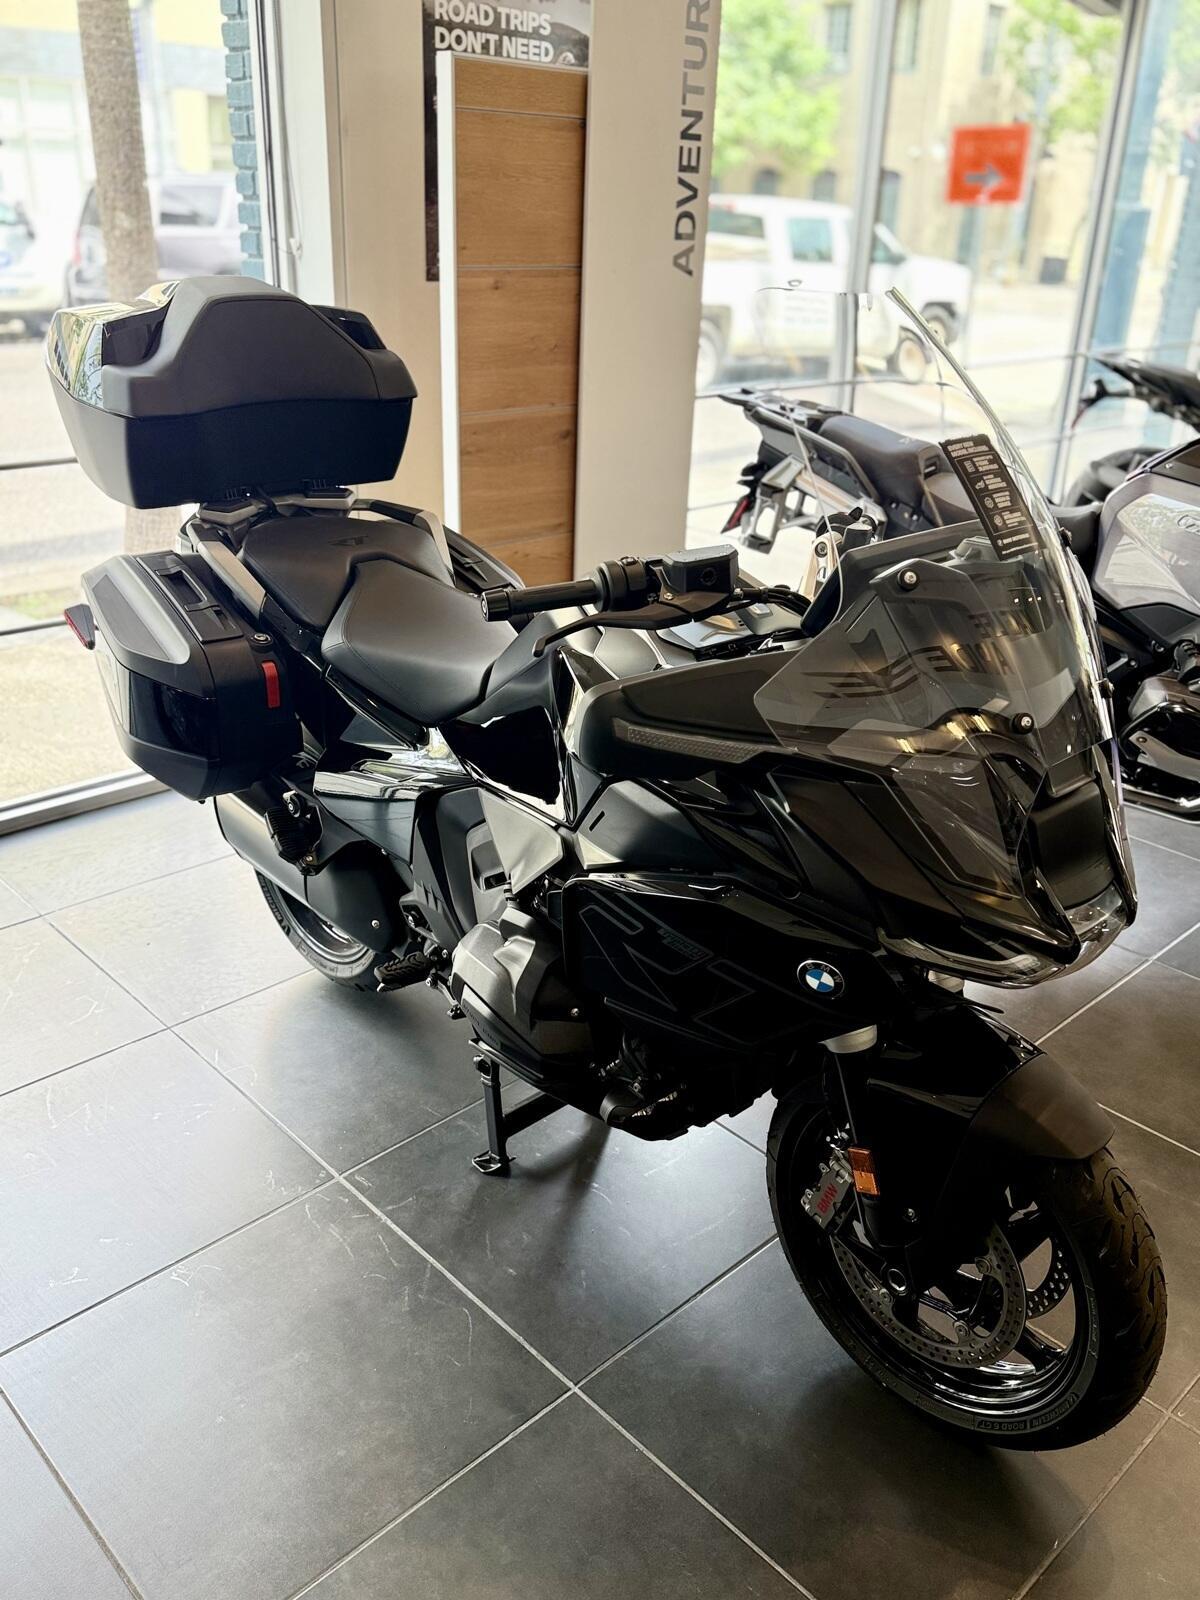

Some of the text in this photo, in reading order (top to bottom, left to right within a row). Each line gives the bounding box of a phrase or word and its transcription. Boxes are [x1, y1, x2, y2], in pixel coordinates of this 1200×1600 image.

[434, 0, 551, 36] ROAD TRIPS
[434, 26, 554, 63] DON'T NEED
[805, 962, 843, 983] BMW
[816, 1183, 838, 1214] BMW
[978, 1421, 993, 1430] GT
[1001, 1421, 1025, 1431] ROAD
